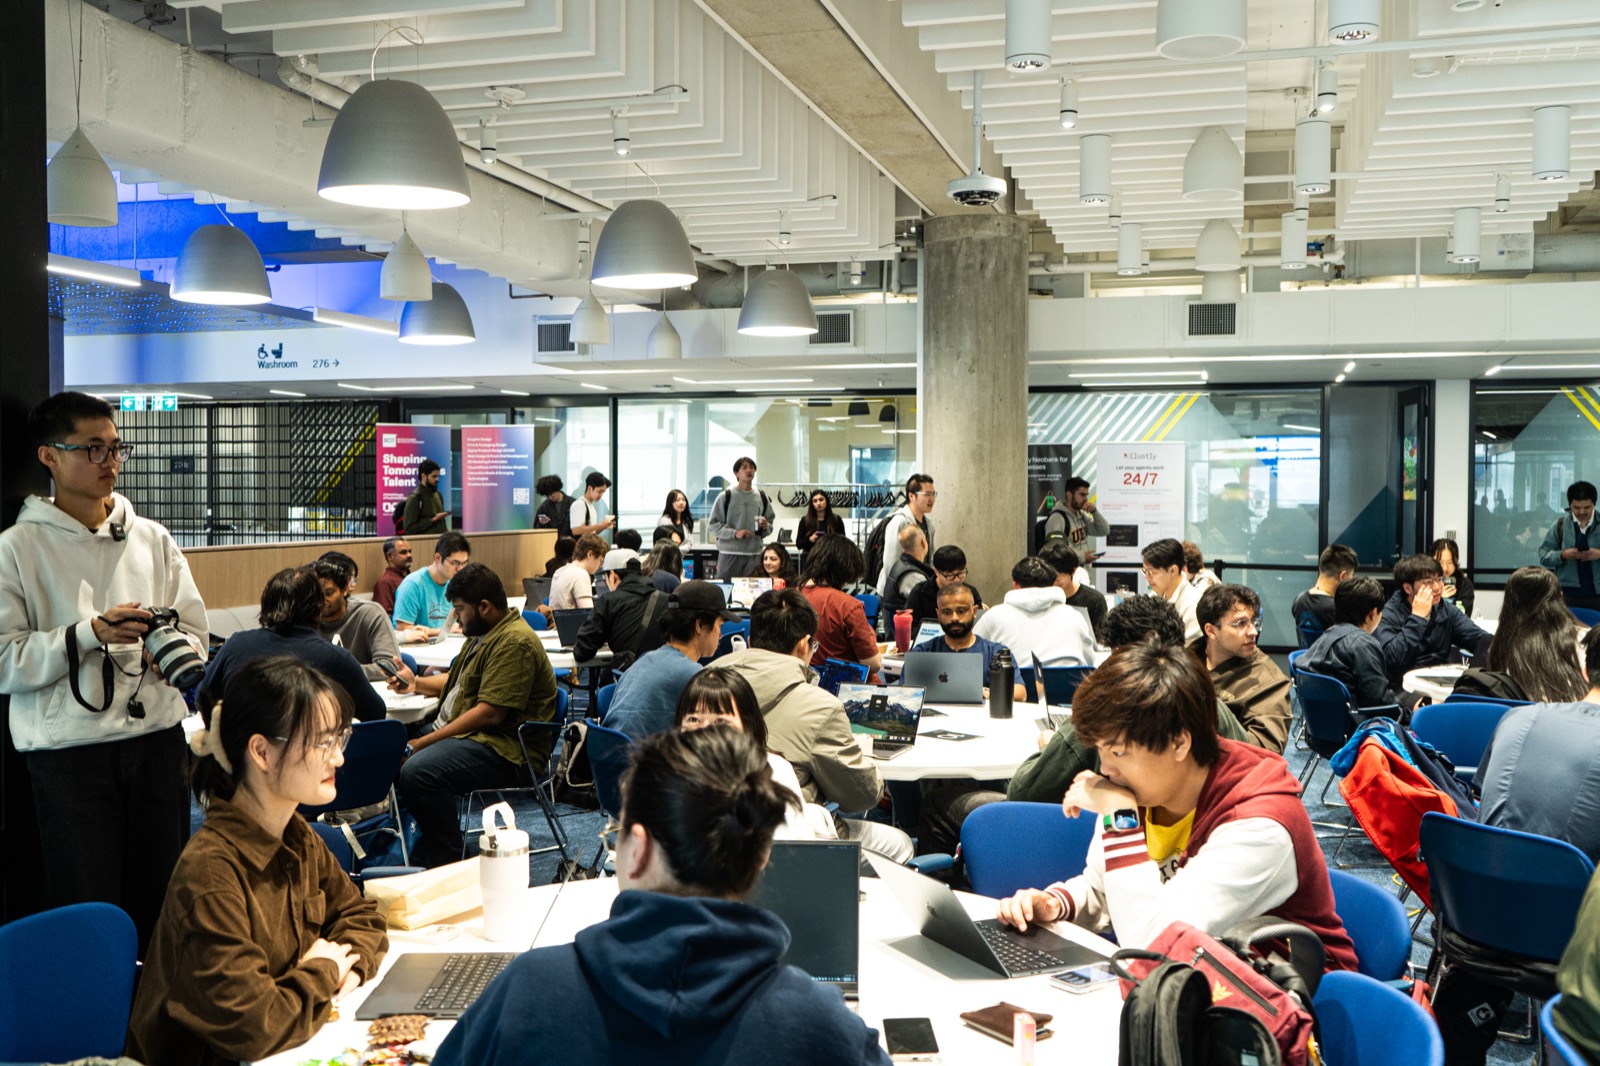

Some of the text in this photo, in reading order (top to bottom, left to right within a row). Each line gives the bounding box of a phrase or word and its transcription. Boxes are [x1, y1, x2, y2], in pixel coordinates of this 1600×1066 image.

[257, 359, 330, 369] Washroom 276
[382, 453, 427, 466] Shapin
[1130, 452, 1157, 460] Clustly
[382, 476, 417, 487] Talent
[1123, 472, 1158, 486] 24/7
